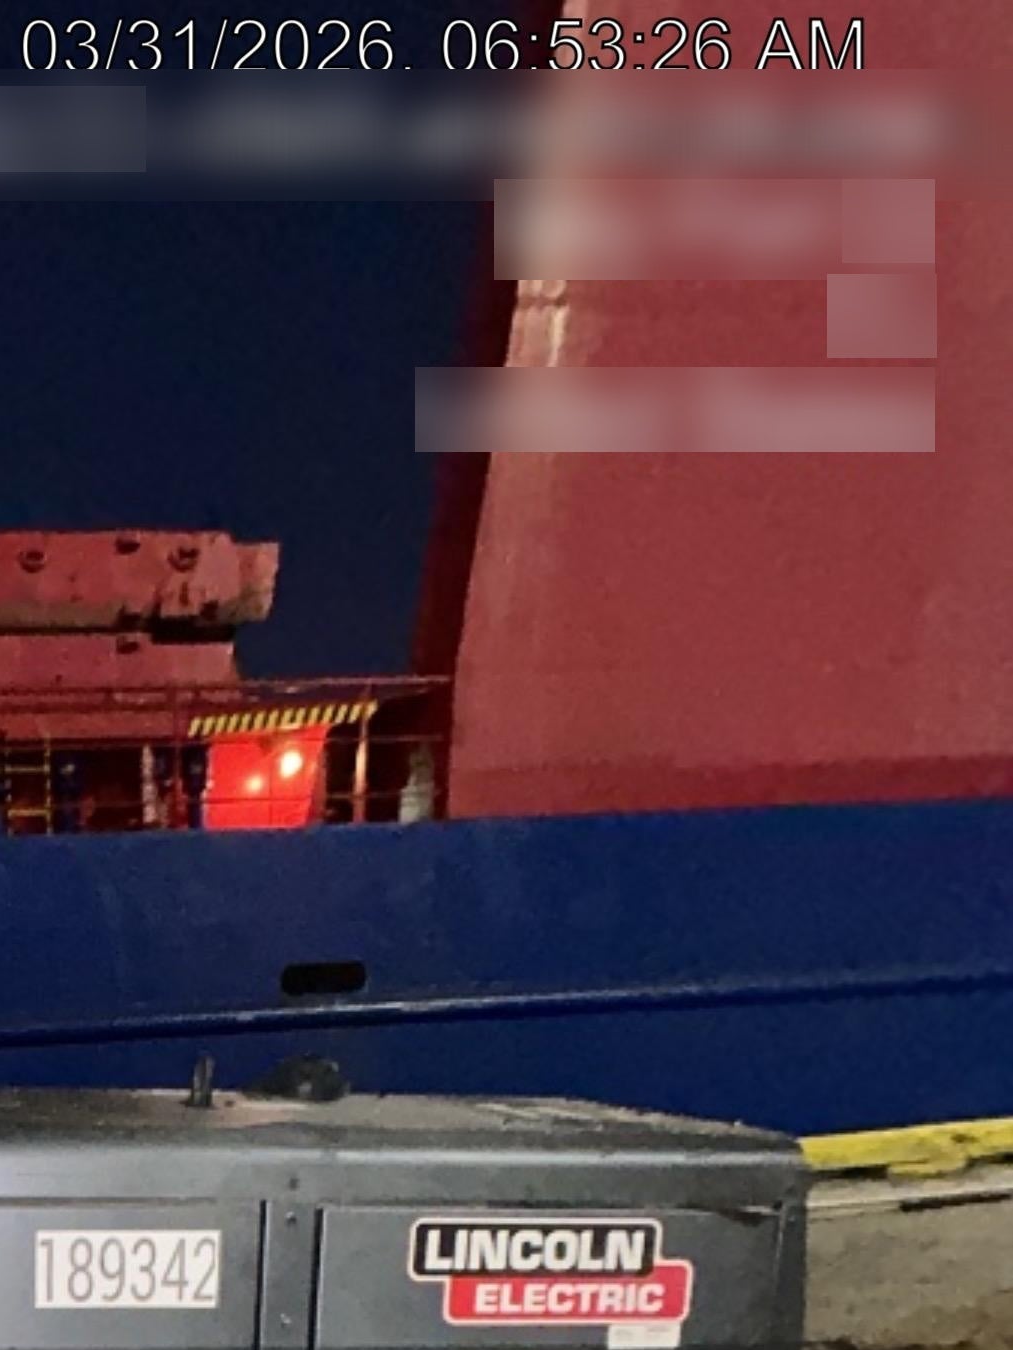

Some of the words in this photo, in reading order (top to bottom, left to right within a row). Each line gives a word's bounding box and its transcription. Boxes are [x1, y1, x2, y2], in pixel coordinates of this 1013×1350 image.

[40, 1237, 217, 1302] 189342
[424, 1229, 646, 1271] LINCOLN
[474, 1282, 666, 1315] ELECTRIC
